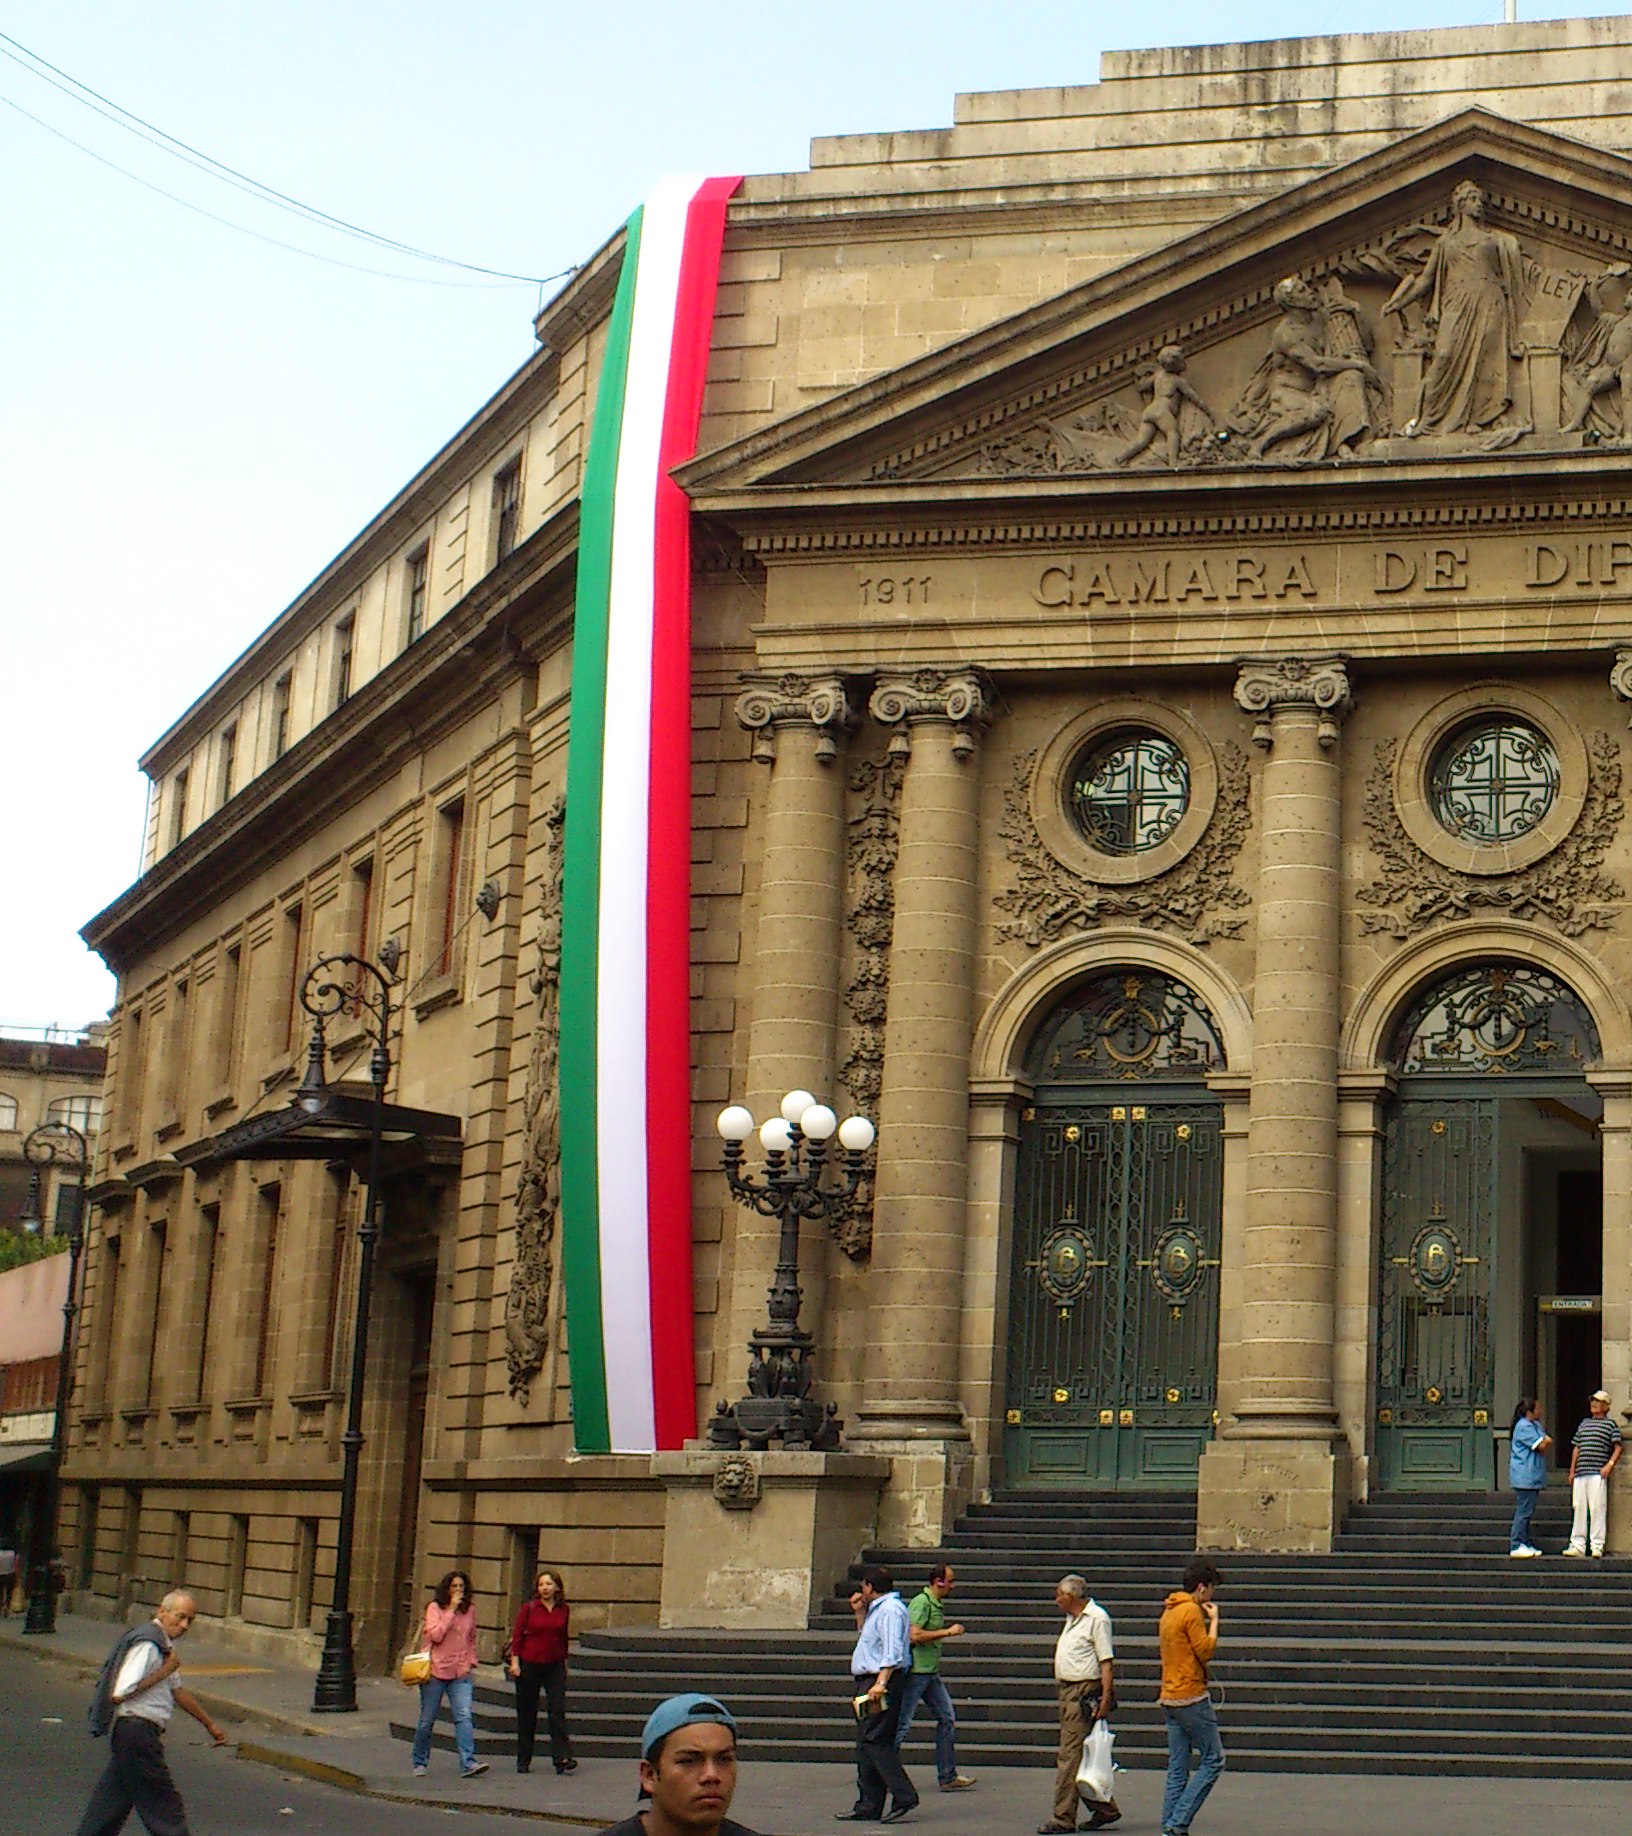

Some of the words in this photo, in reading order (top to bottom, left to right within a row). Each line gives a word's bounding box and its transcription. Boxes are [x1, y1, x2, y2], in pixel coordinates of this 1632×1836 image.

[1542, 276, 1579, 300] LEY
[859, 576, 931, 606] 1911
[1032, 555, 1317, 608] CAMARA
[1374, 546, 1468, 594] DE
